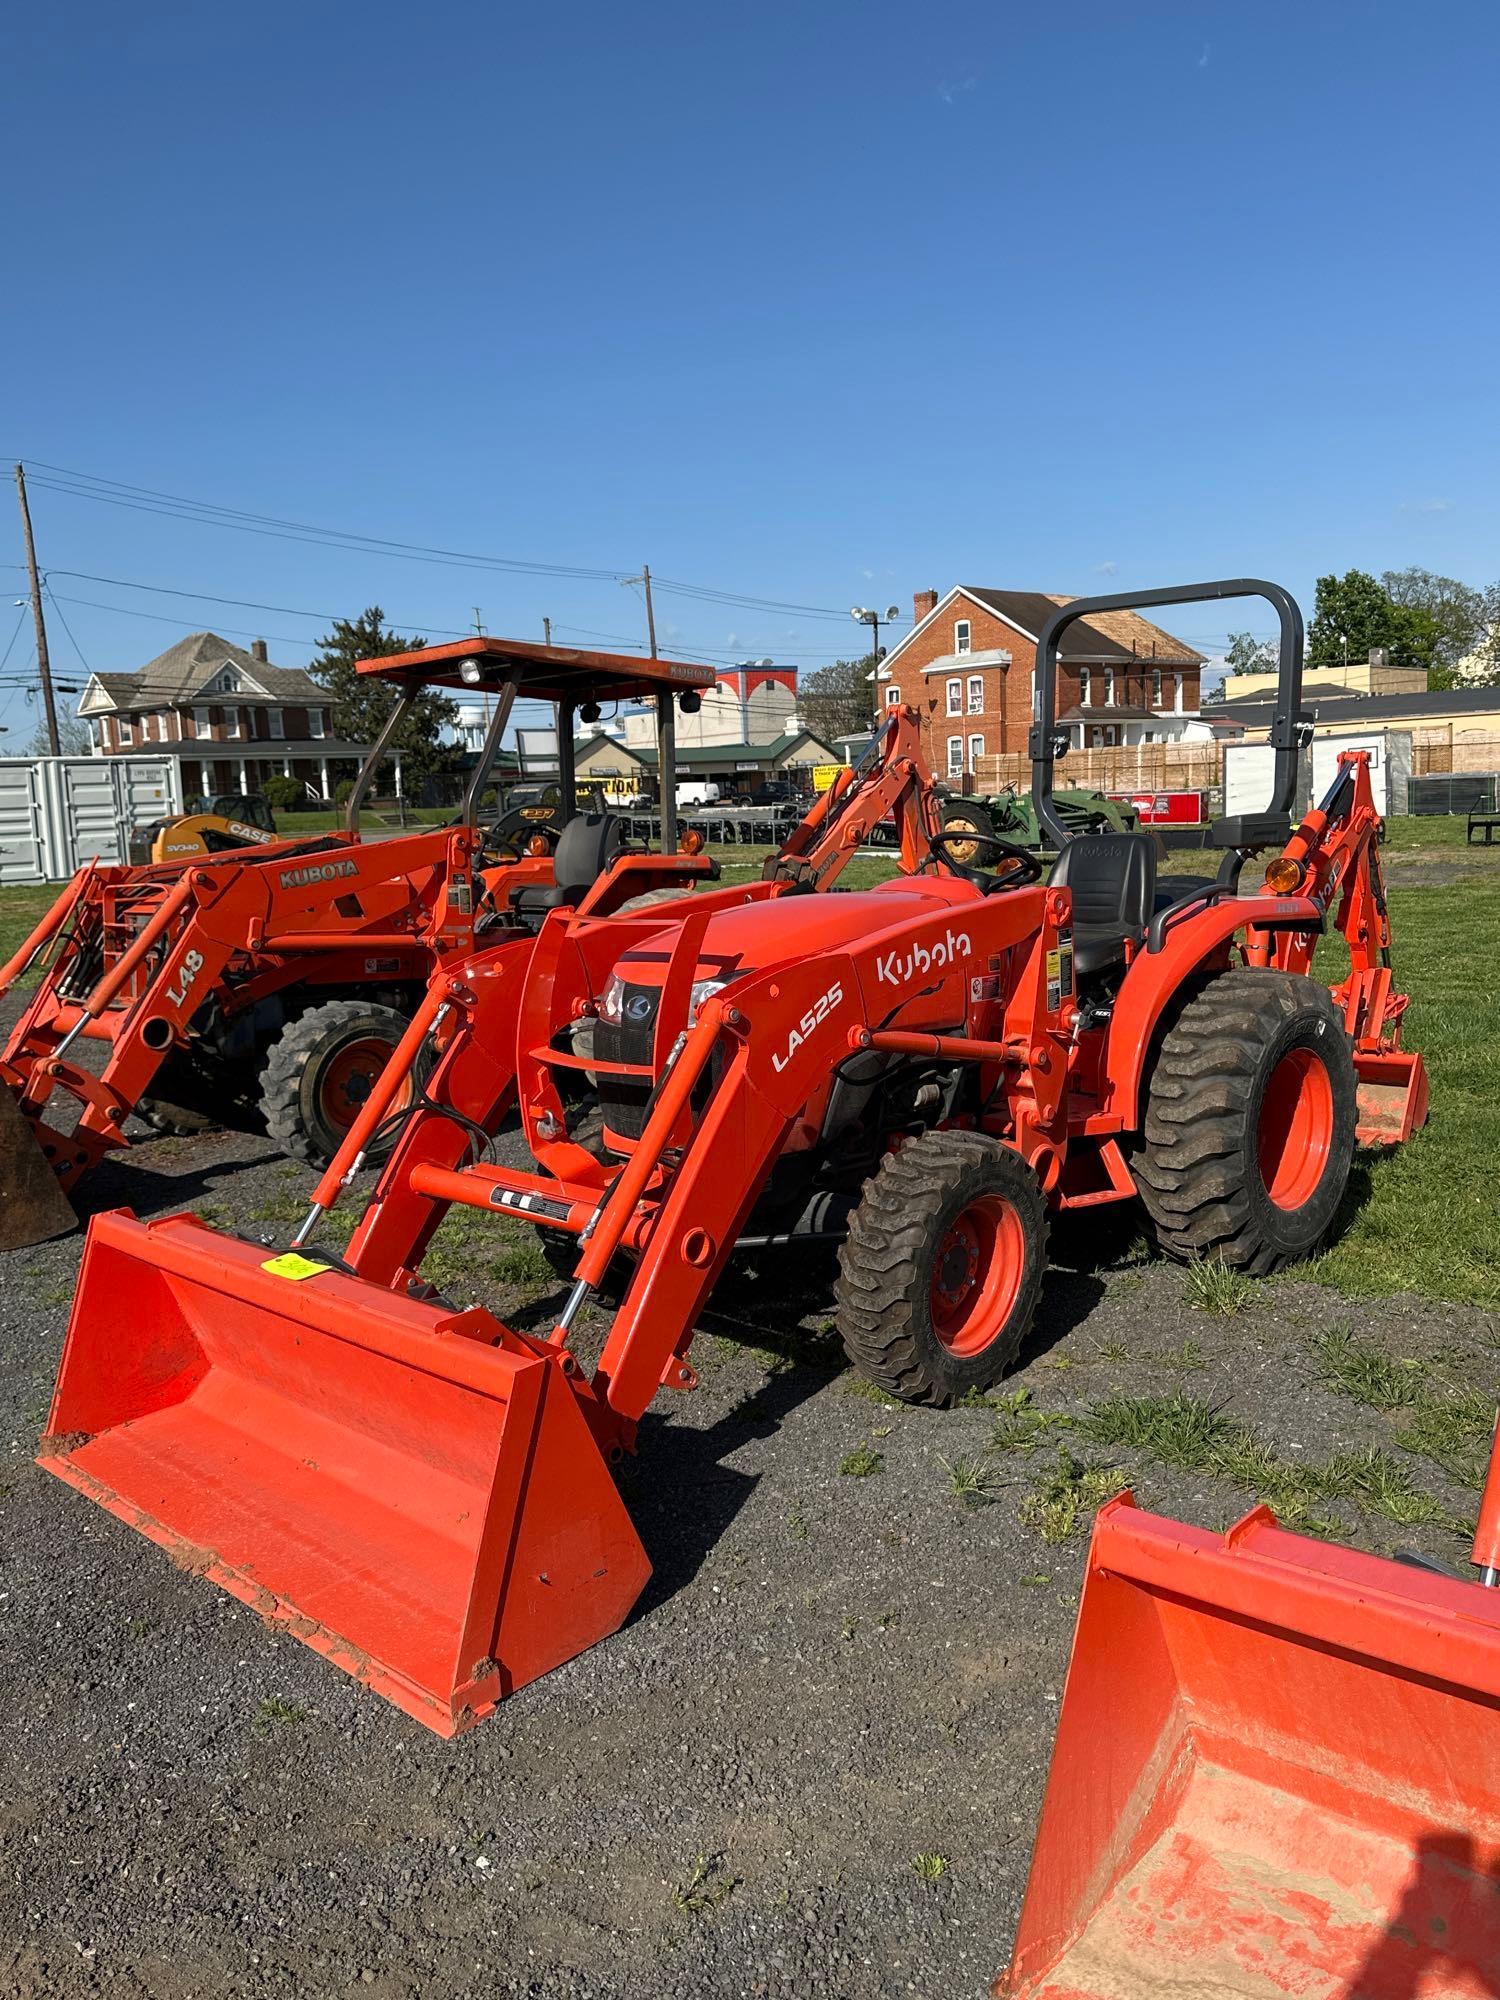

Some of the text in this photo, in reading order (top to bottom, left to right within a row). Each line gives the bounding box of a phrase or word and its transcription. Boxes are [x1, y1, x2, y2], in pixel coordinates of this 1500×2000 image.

[671, 665, 714, 681] KUBOTA
[167, 843, 200, 852] SV340
[229, 823, 272, 844] CASE
[280, 859, 359, 889] KUBOTA
[876, 929, 972, 986] Kubota
[165, 949, 204, 1008] L48
[772, 980, 843, 1073] LA525
